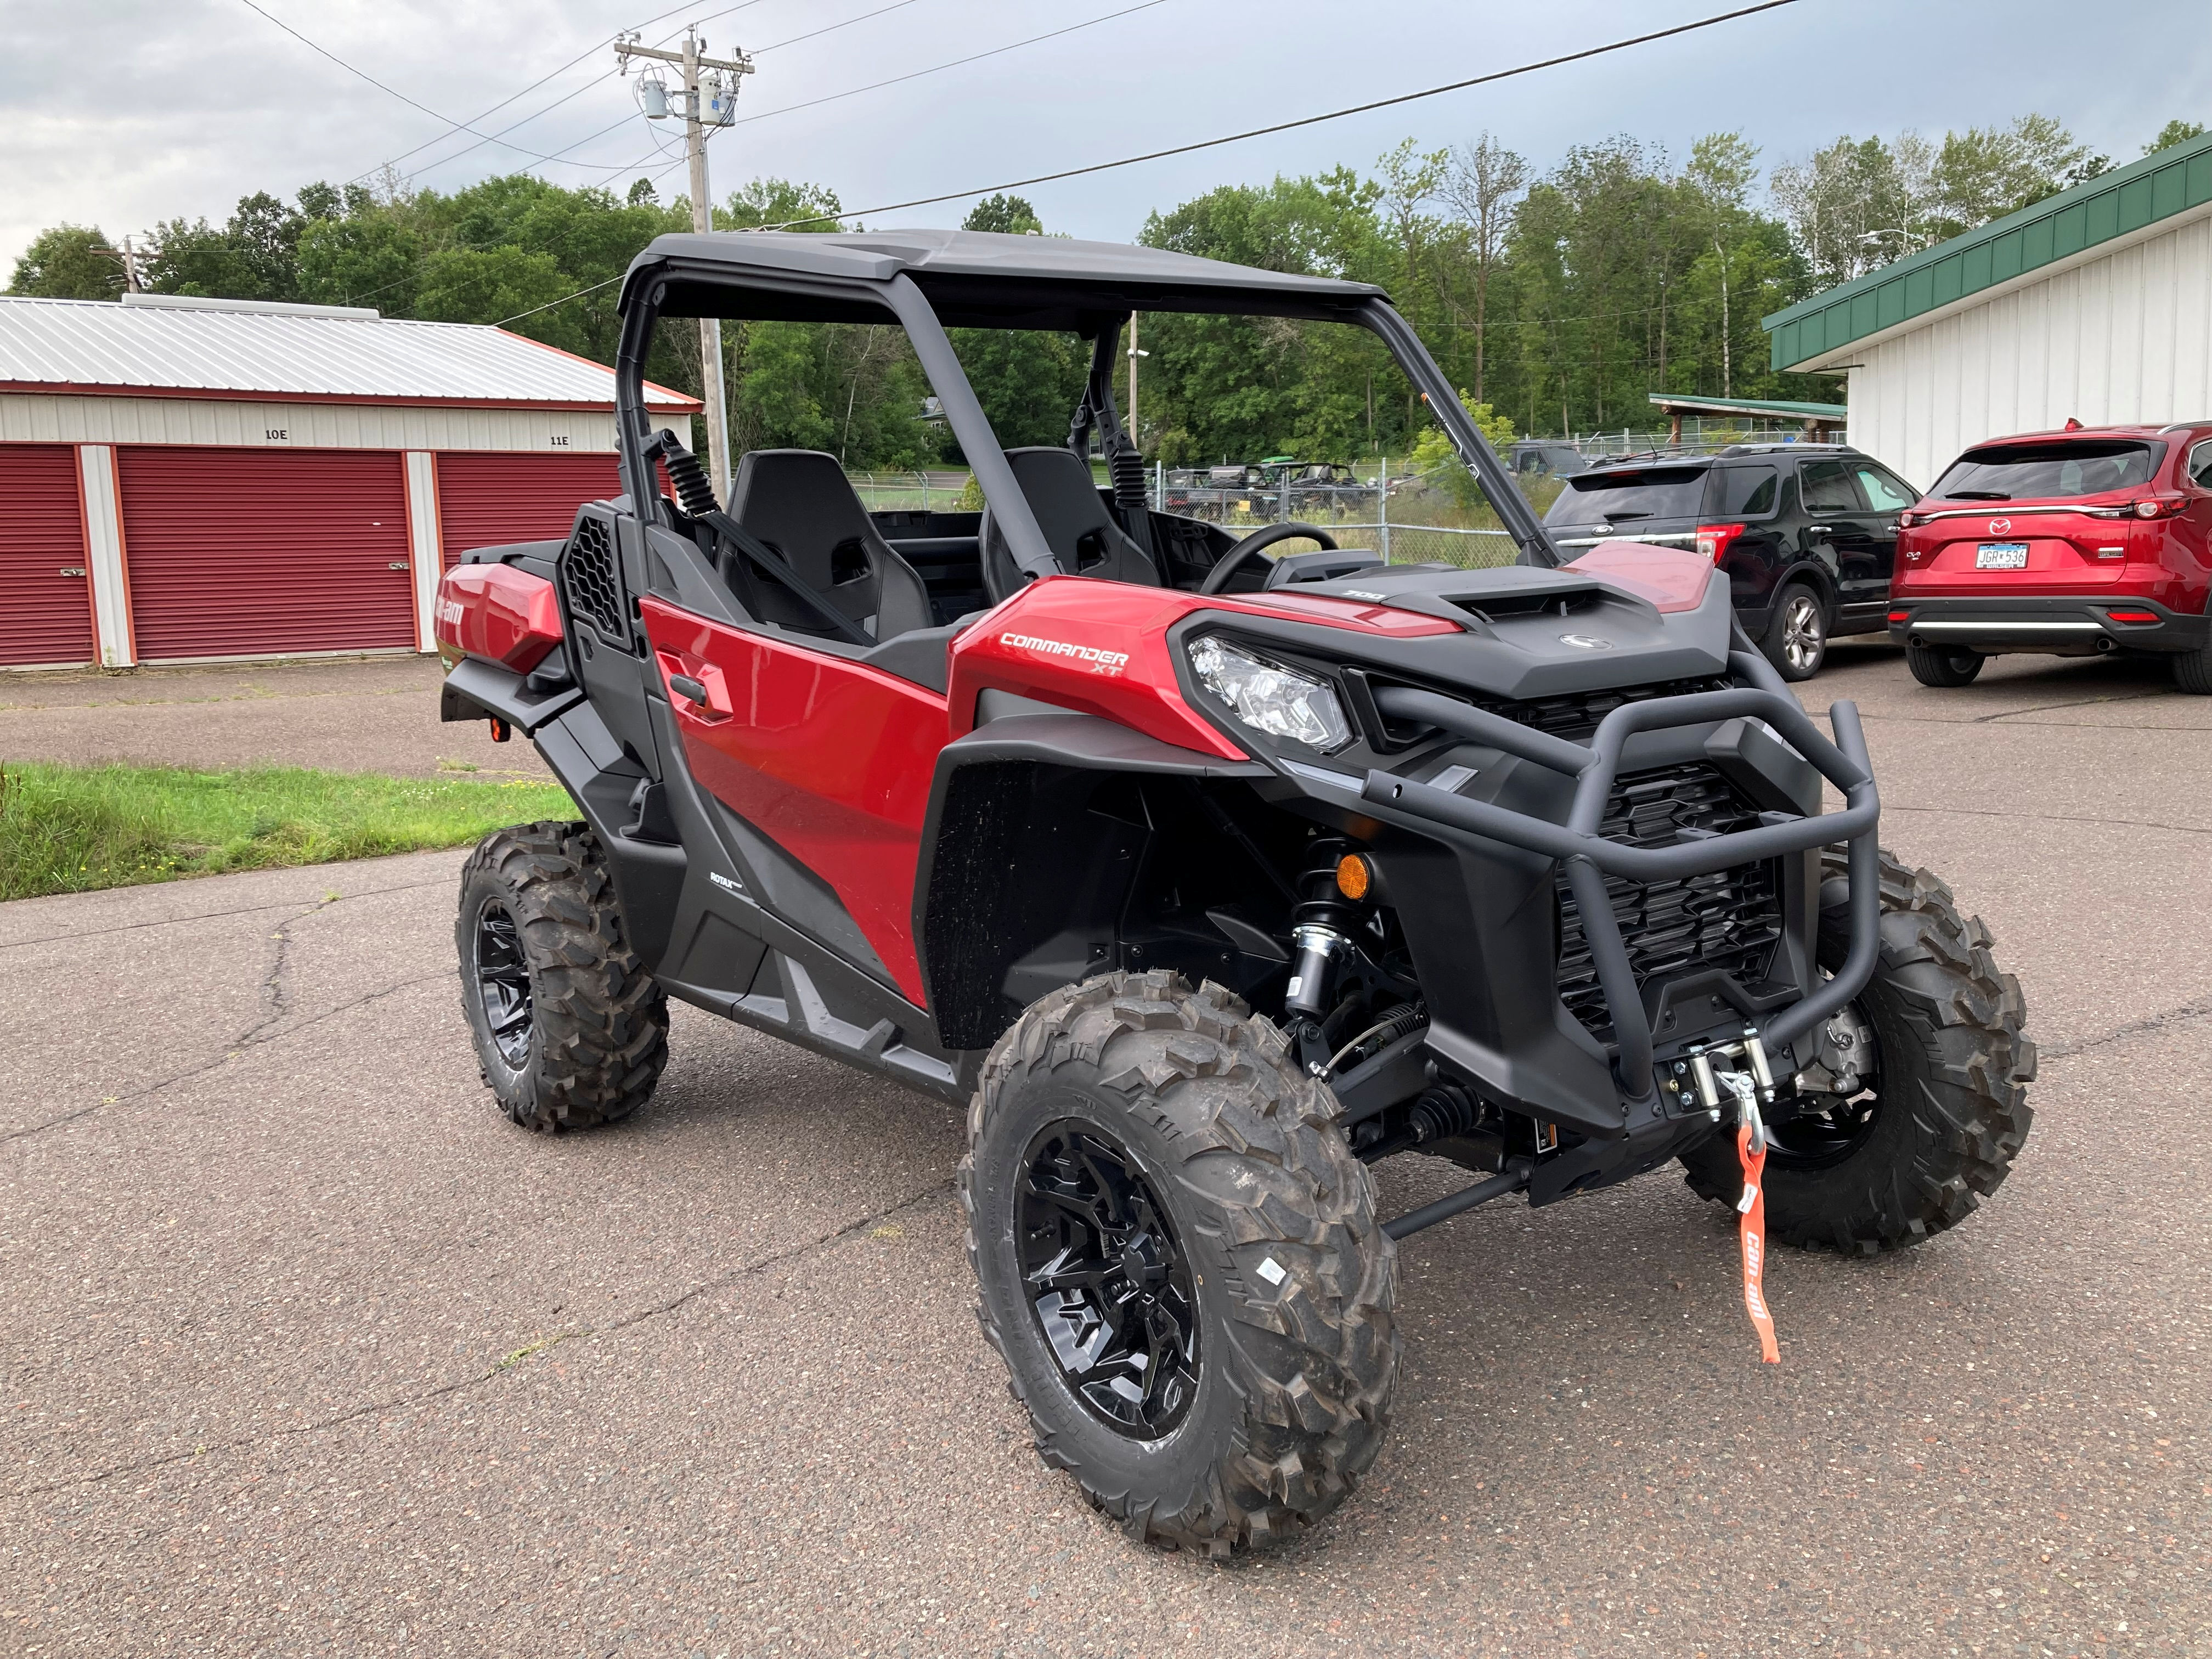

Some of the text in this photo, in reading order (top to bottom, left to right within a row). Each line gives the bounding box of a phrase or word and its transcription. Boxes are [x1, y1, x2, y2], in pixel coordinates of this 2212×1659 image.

[266, 430, 287, 439] 10E
[550, 436, 569, 445] 11E
[1979, 550, 2024, 563] JGR 536
[1342, 589, 1386, 600] 700
[1000, 633, 1129, 667] COMMANDER
[1090, 662, 1124, 676] XT
[710, 871, 733, 889] ROTAX
[1747, 1231, 1768, 1319] can-am
